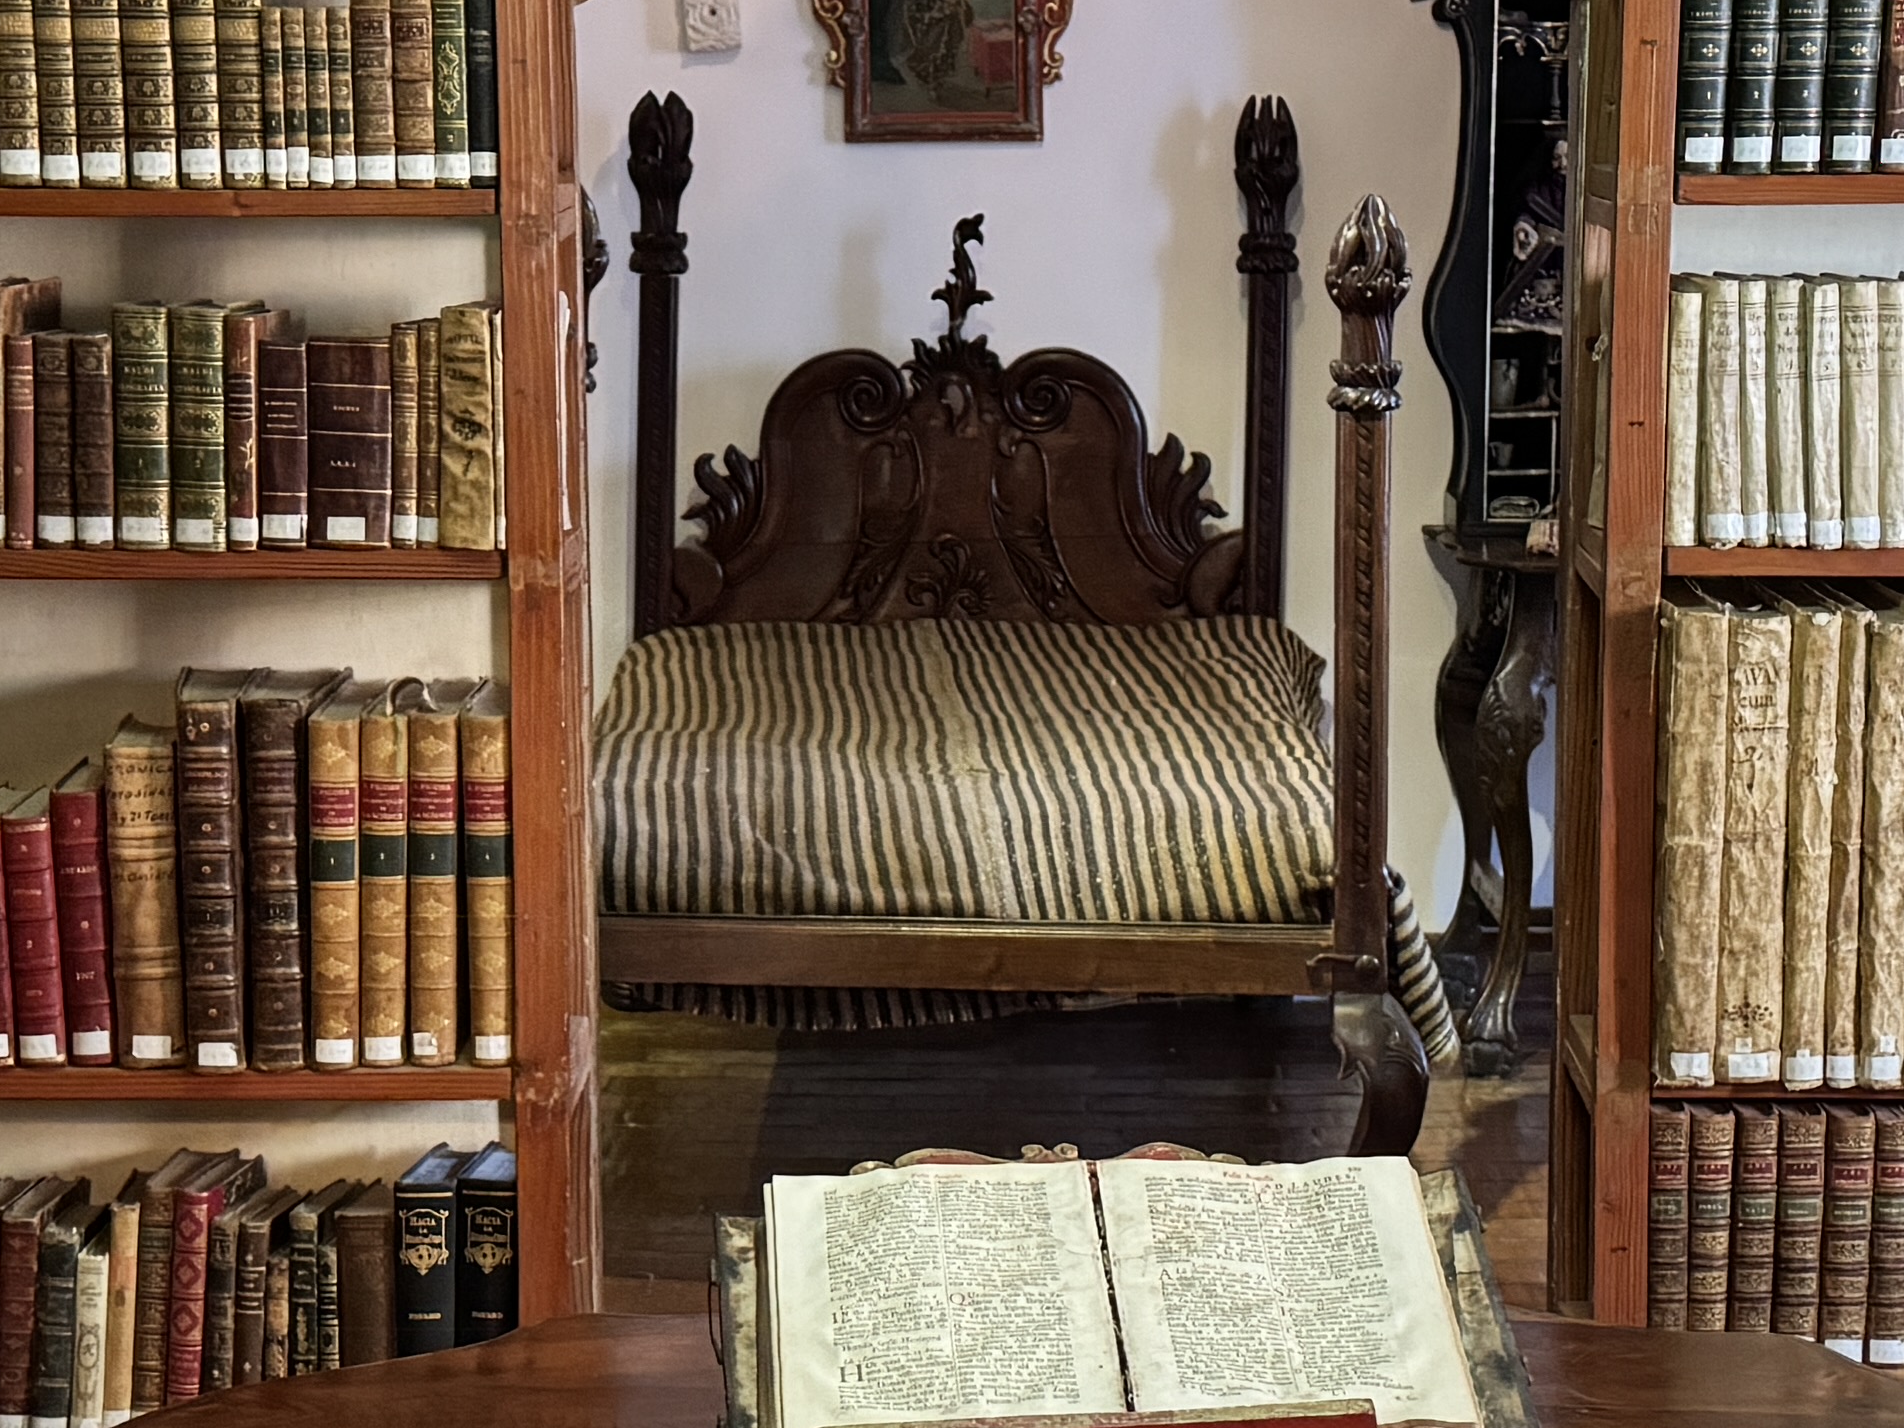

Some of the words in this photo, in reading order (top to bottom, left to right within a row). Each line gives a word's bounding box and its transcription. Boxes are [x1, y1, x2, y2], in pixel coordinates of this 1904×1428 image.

[1738, 695, 1776, 710] cum
[410, 1216, 437, 1227] HACIA
[476, 1215, 502, 1226] HACIA
